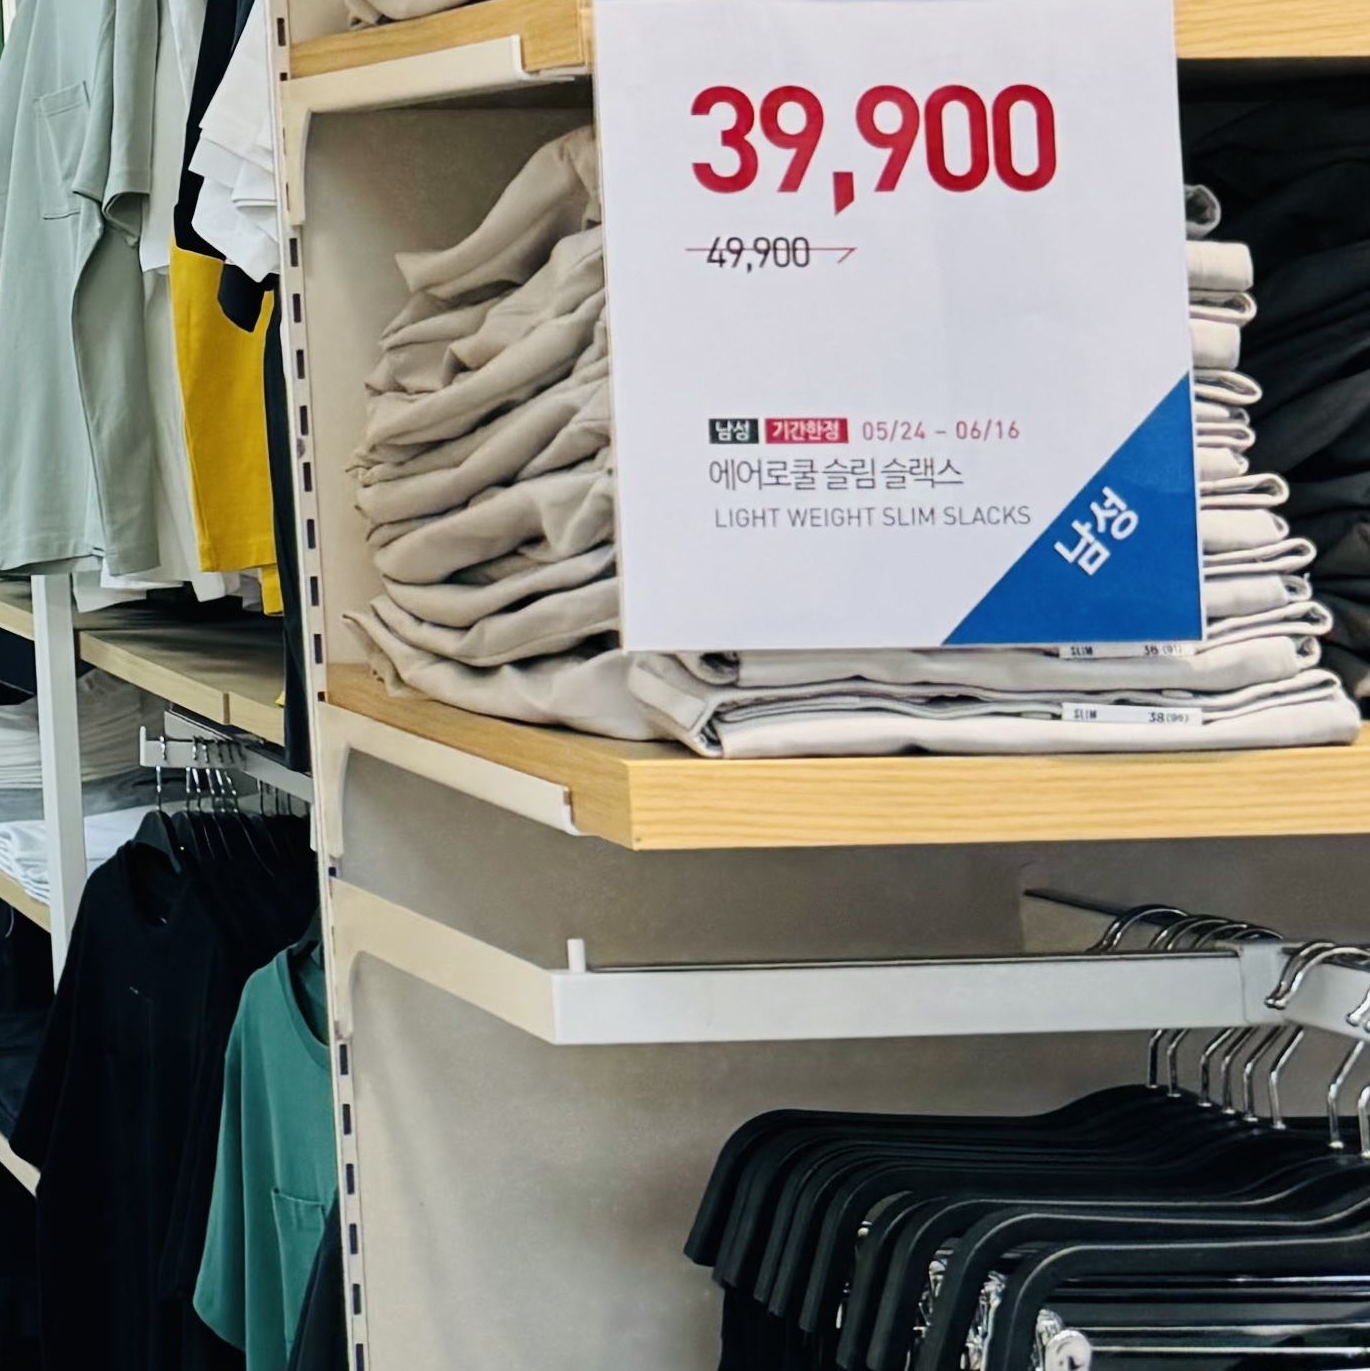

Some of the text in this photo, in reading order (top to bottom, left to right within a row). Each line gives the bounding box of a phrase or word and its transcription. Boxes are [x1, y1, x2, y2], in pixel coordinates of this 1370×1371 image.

[691, 83, 1057, 217] 39,900
[706, 236, 811, 272] 49,900
[714, 419, 751, 442] 남성
[772, 420, 841, 440] 기간한정
[862, 420, 925, 442] 05/24
[955, 419, 1021, 441] 06/16
[709, 457, 964, 491] 에어로쿨 슬림 슬랙스
[715, 506, 1031, 528] LIGHT WEIGHT SLIM SLACKS
[1054, 486, 1138, 576] 남성
[1071, 646, 1093, 656] SLIM
[1074, 709, 1097, 720] SLIM
